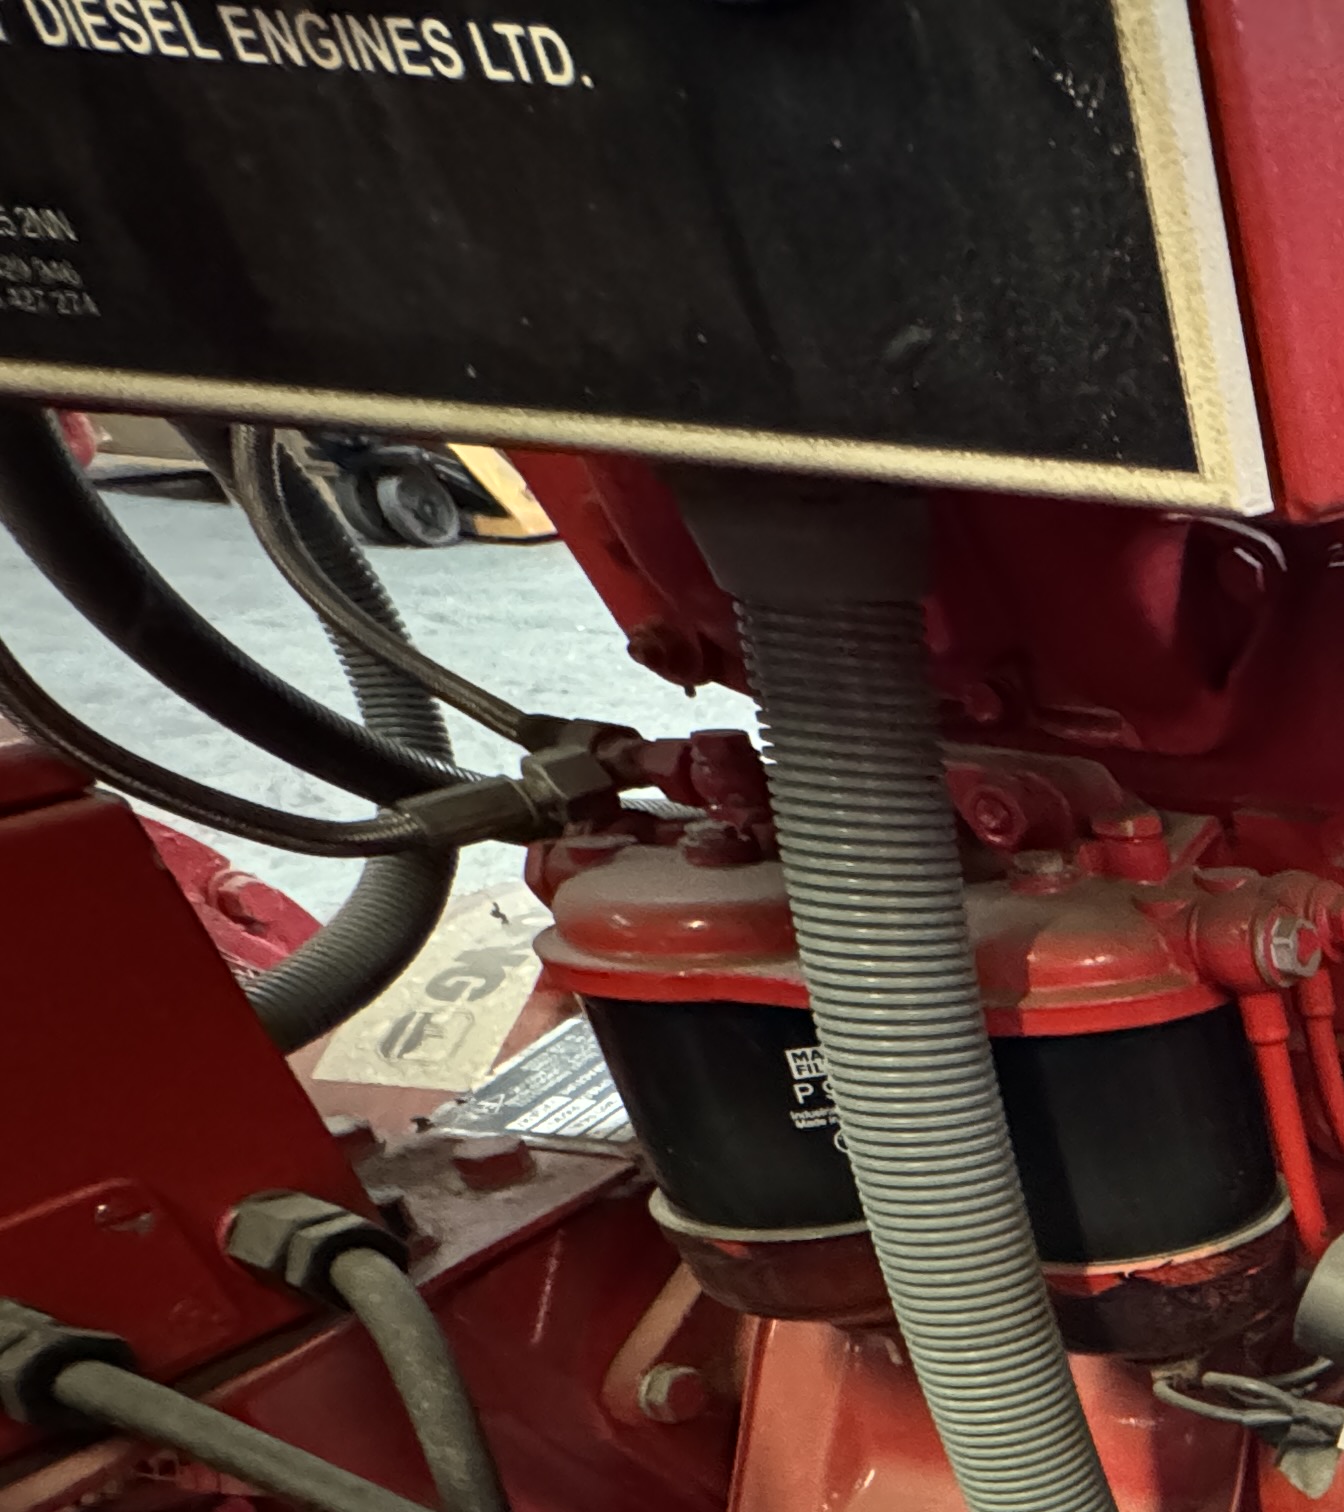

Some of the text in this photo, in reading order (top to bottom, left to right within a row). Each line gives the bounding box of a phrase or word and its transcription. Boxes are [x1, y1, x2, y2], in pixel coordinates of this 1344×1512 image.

[22, 0, 594, 88] DIESEL ENGINES LTD.
[790, 1048, 824, 1064] MA
[795, 1062, 824, 1076] FIL
